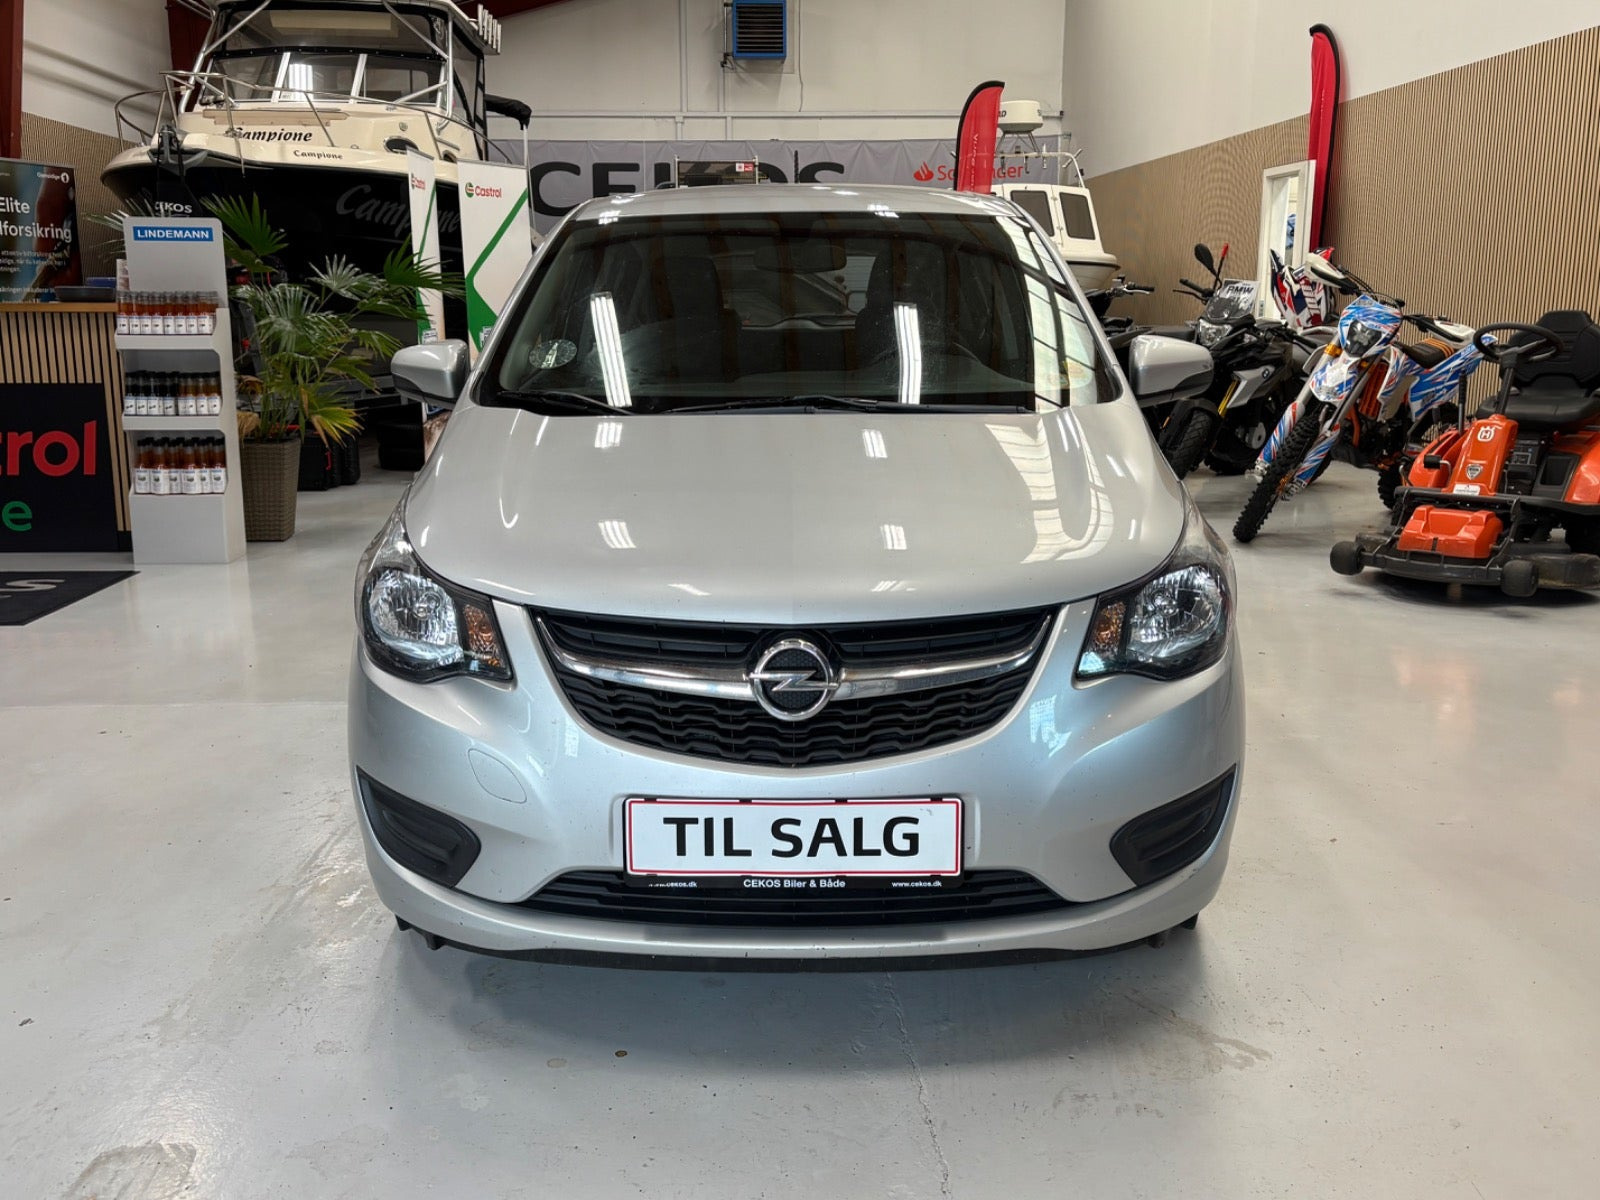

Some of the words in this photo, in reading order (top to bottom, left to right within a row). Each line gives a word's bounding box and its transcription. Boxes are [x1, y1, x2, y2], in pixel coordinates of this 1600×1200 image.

[236, 127, 313, 142] ampione
[293, 149, 343, 160] Campione
[475, 185, 502, 199] Castrol
[0, 197, 31, 214] Elite
[137, 229, 210, 240] LINDEMANN
[0, 420, 97, 477] rol
[662, 816, 752, 857] TIL
[770, 816, 920, 858] SALG
[743, 879, 781, 888] CEKOS
[783, 879, 807, 888] Biler
[809, 879, 817, 888] &
[819, 878, 846, 888] Både
[892, 880, 942, 888] www.cekos.dk
